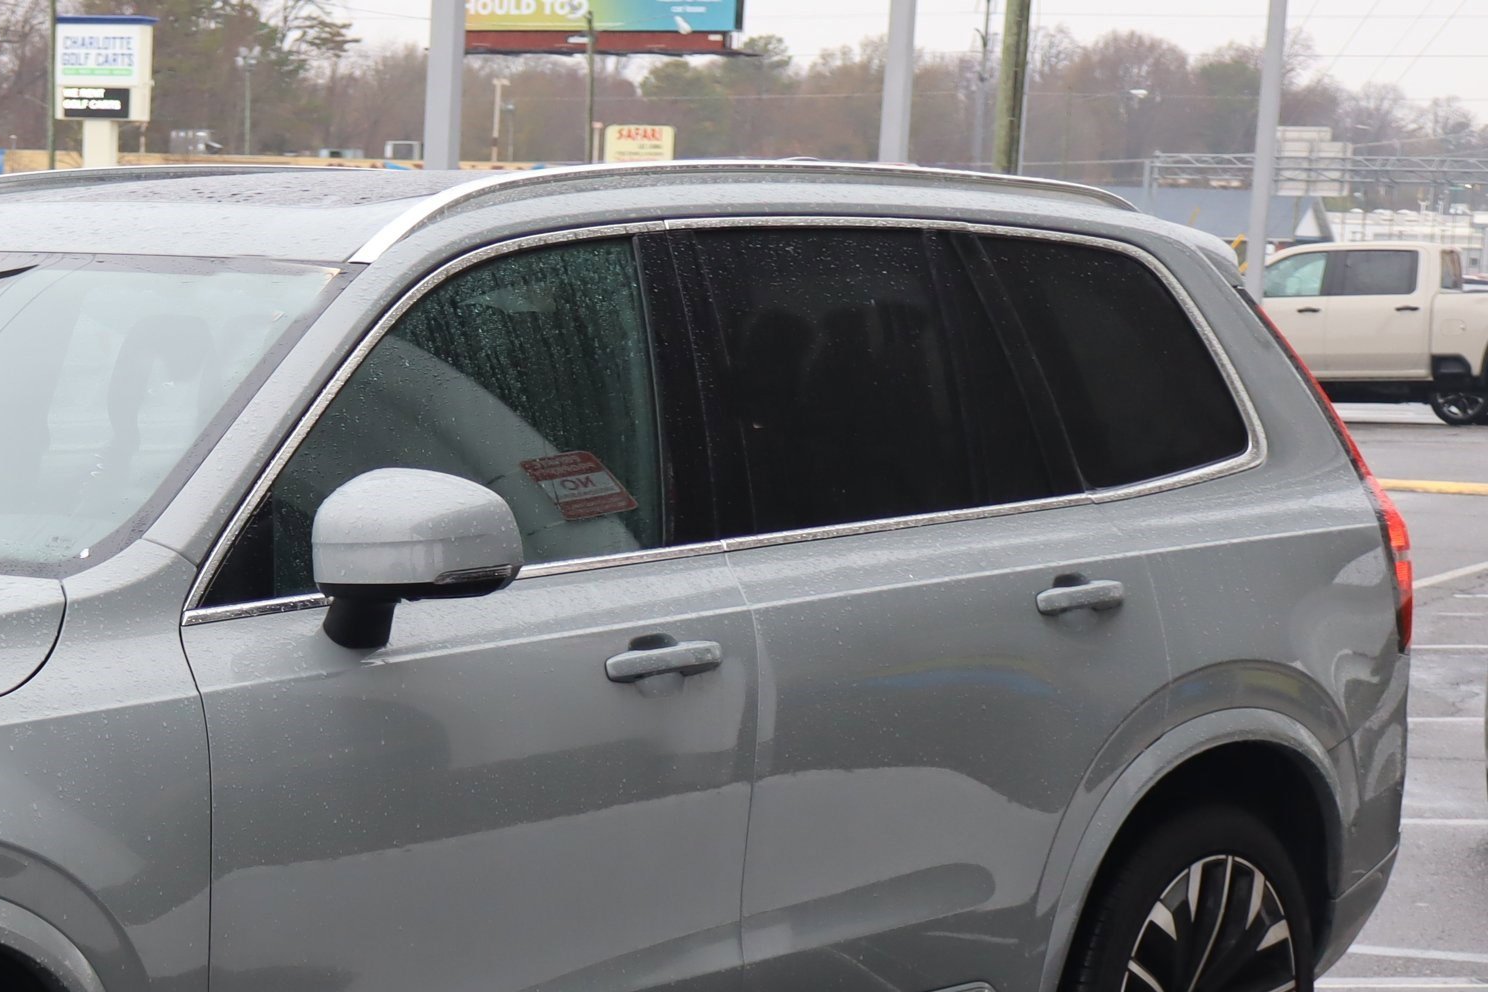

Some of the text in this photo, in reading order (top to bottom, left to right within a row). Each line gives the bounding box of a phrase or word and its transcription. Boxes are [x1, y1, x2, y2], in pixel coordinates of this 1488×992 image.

[63, 36, 133, 50] CHARLOTTE
[62, 52, 134, 66] GOLF CARTS
[616, 127, 664, 140] SAFARI
